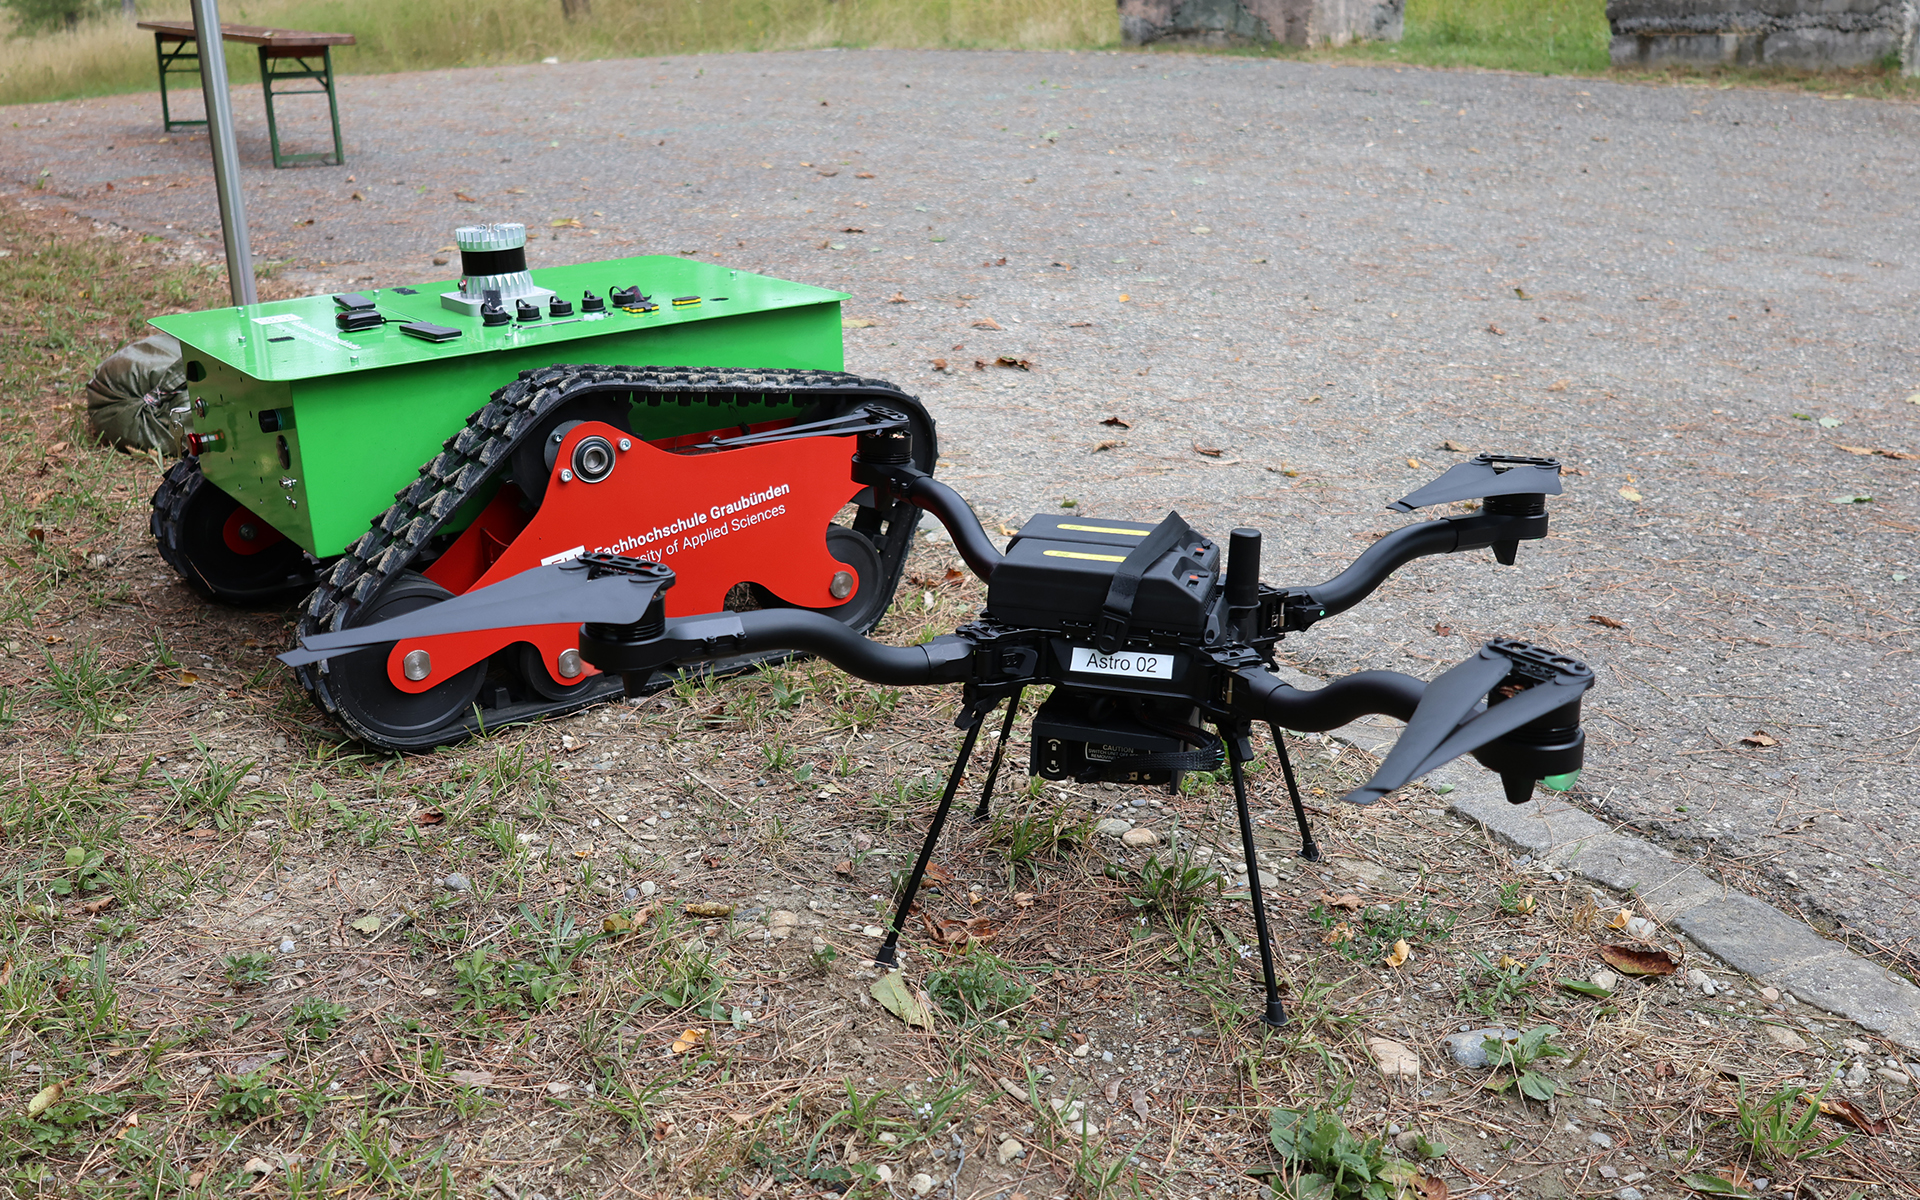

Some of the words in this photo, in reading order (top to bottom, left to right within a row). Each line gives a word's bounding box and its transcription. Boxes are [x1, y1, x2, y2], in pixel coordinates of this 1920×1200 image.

[710, 483, 790, 519] Graubünden
[666, 539, 679, 555] of
[683, 522, 729, 549] Applied
[731, 504, 786, 531] Sciences
[1086, 653, 1131, 671] Astro
[1136, 656, 1158, 673] 02
[1102, 744, 1135, 754] CAUTION
